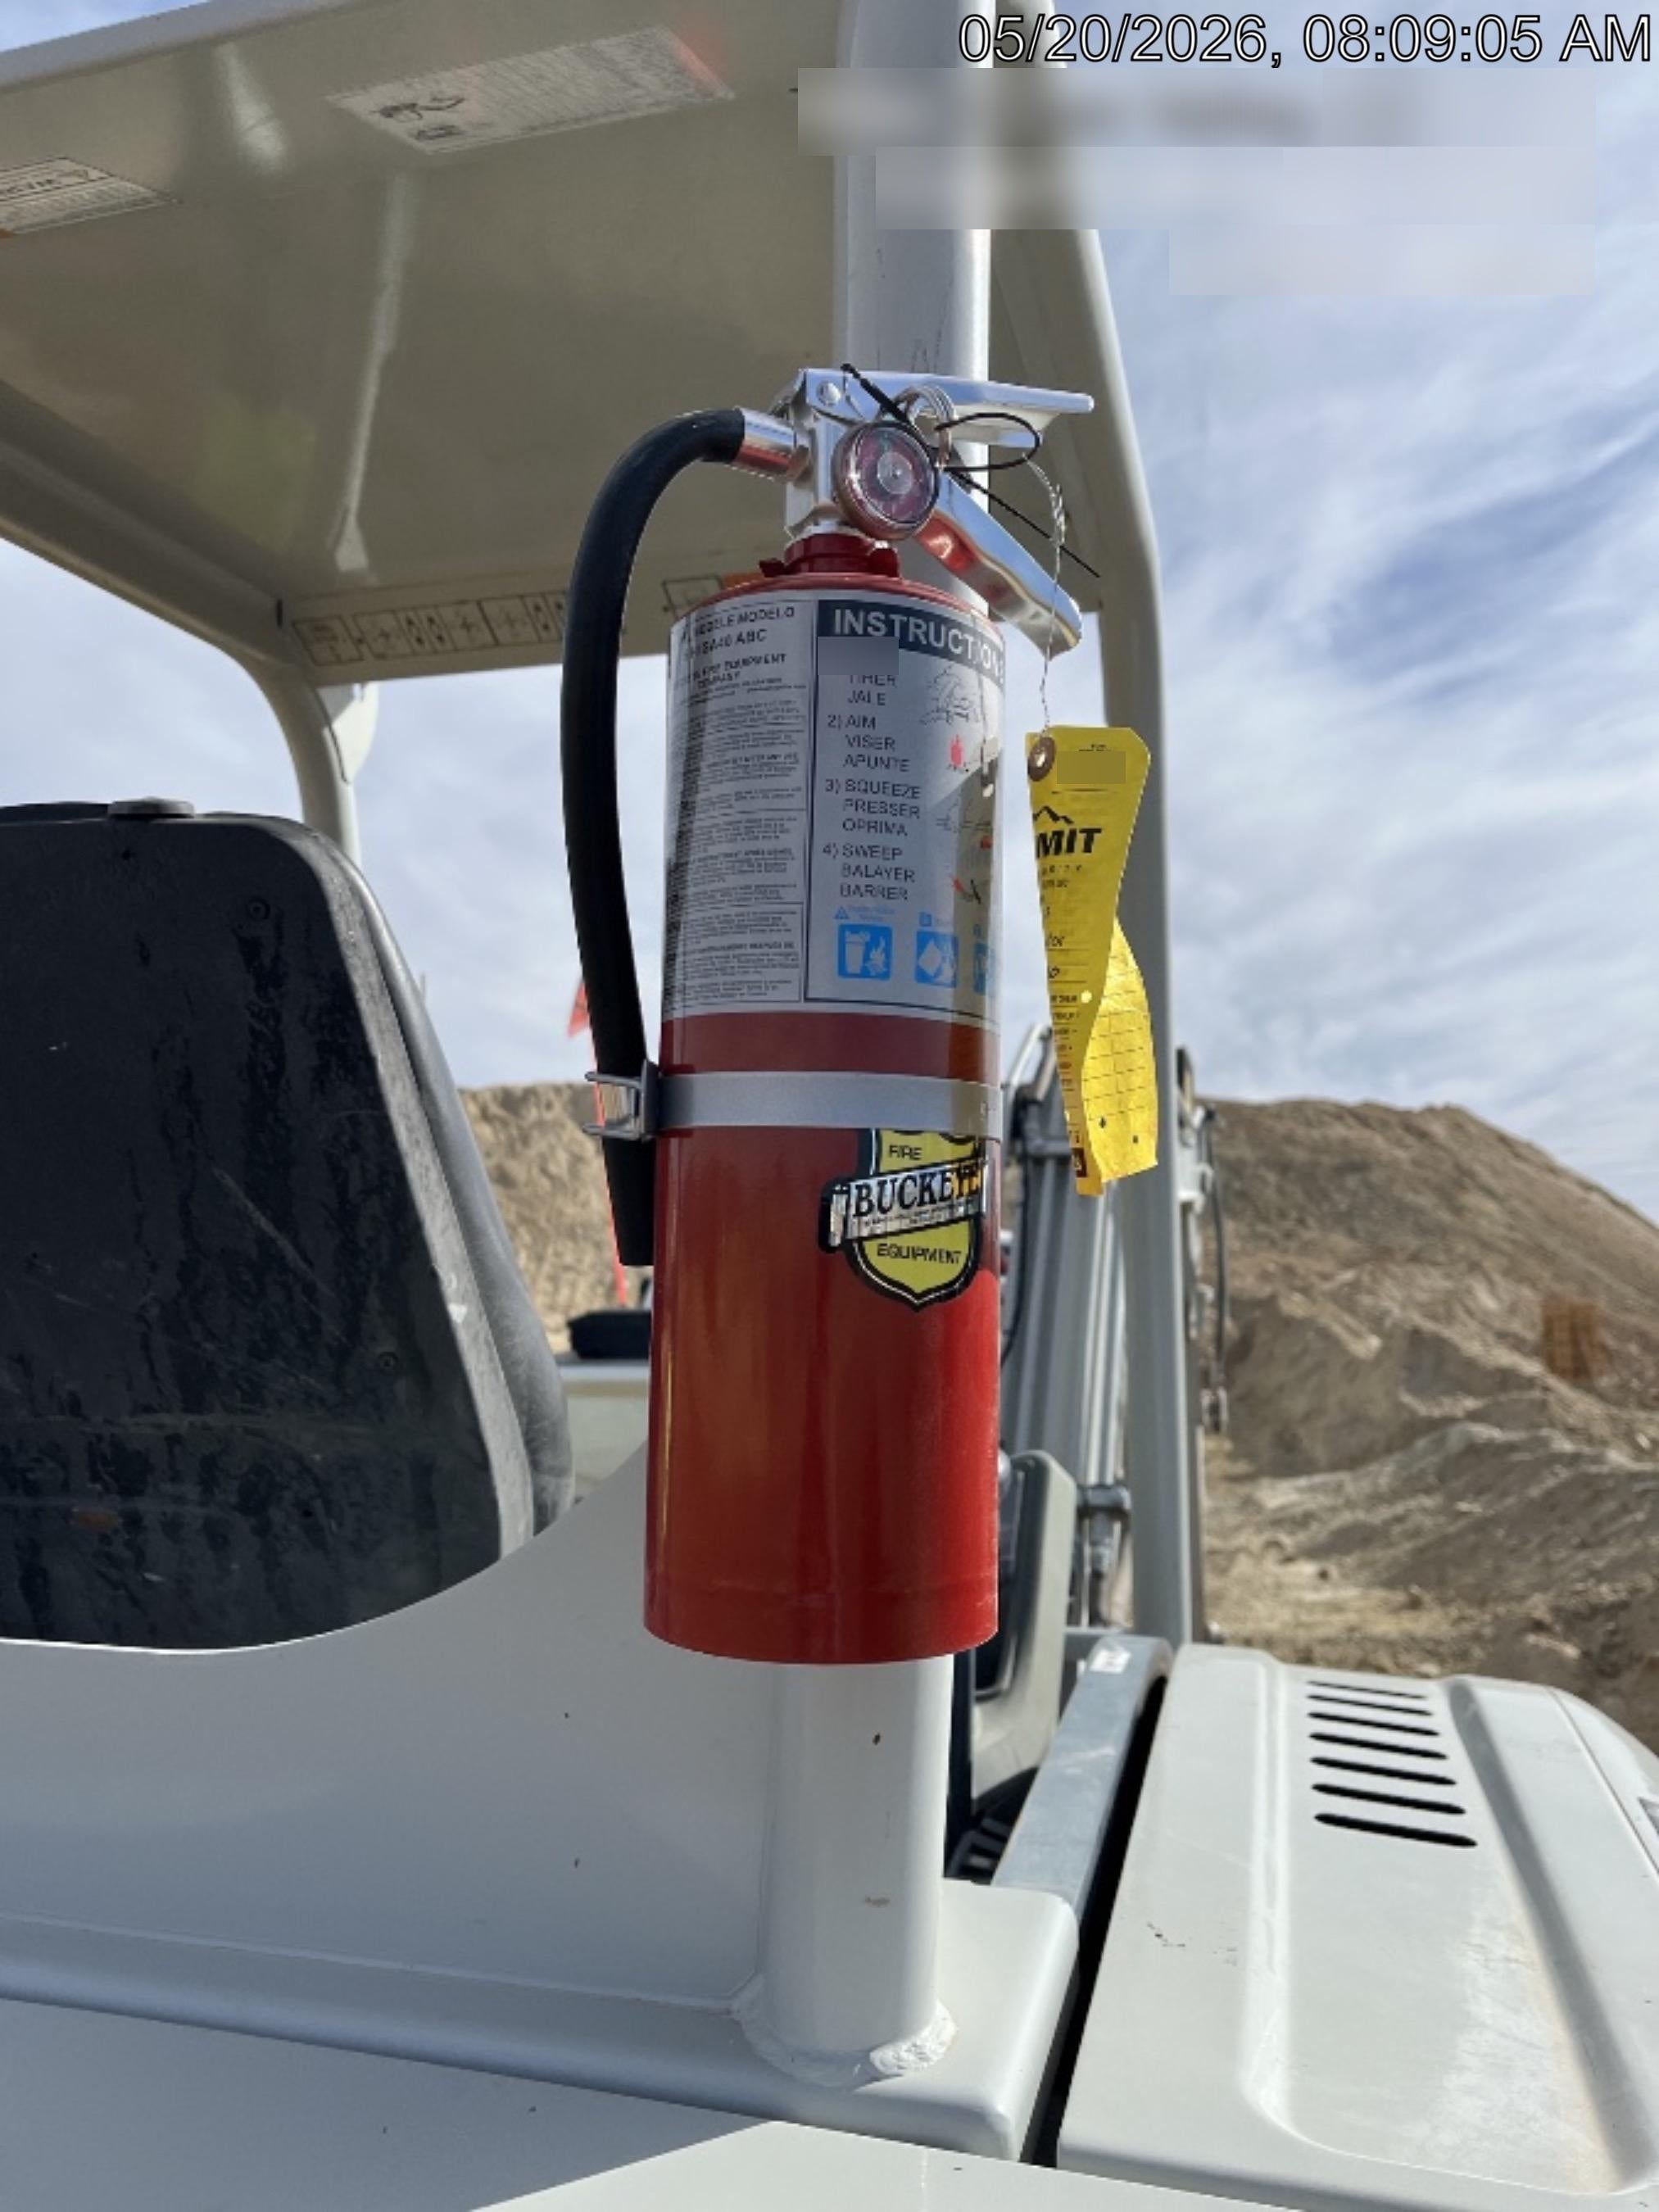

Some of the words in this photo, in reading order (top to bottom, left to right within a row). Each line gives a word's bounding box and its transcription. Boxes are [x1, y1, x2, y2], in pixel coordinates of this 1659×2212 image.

[737, 628, 767, 645] ABC
[847, 690, 886, 706] JALE
[827, 714, 841, 730] 2)
[845, 715, 877, 730] AIM
[845, 735, 895, 751] VISER
[843, 754, 910, 772] APUNTE
[825, 779, 840, 794] 3)
[845, 779, 922, 800] SQUEEZE
[842, 798, 920, 819] PRESSER
[842, 818, 909, 836] OPRIMA
[823, 843, 839, 859] 4)
[841, 844, 904, 861] SWEEP
[841, 863, 915, 883] BALAYER
[840, 883, 909, 900] BARRER
[889, 1145, 922, 1160] FIRE
[877, 1243, 963, 1264] EQUIPMENT
